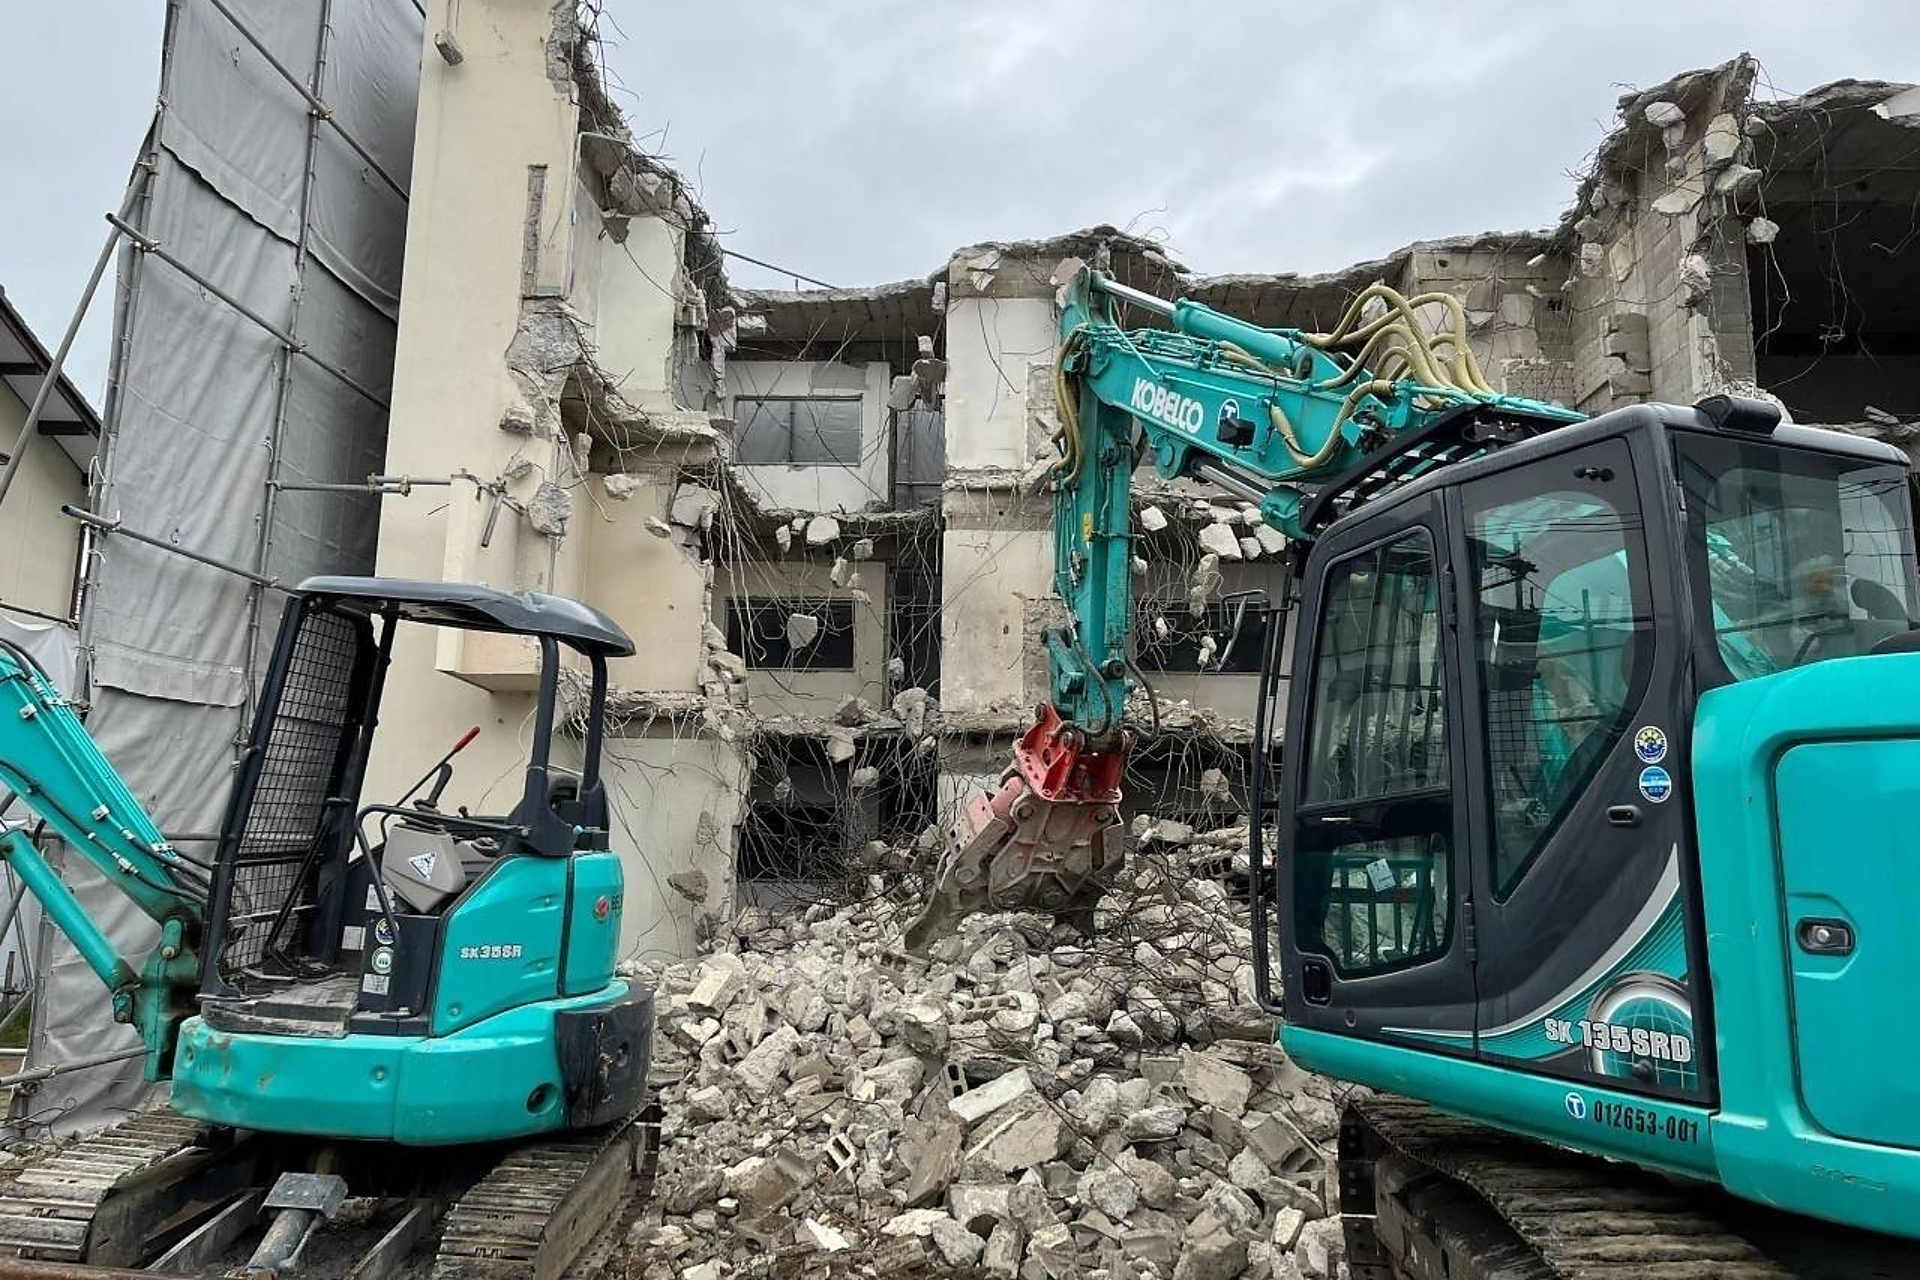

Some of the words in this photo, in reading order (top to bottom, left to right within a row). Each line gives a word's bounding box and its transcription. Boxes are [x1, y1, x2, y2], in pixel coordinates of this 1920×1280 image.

[1131, 378, 1204, 434] KOBELCO
[1544, 1018, 1573, 1043] SK
[1579, 1020, 1692, 1062] 135SRD
[1594, 1100, 1698, 1144] 012653-001
